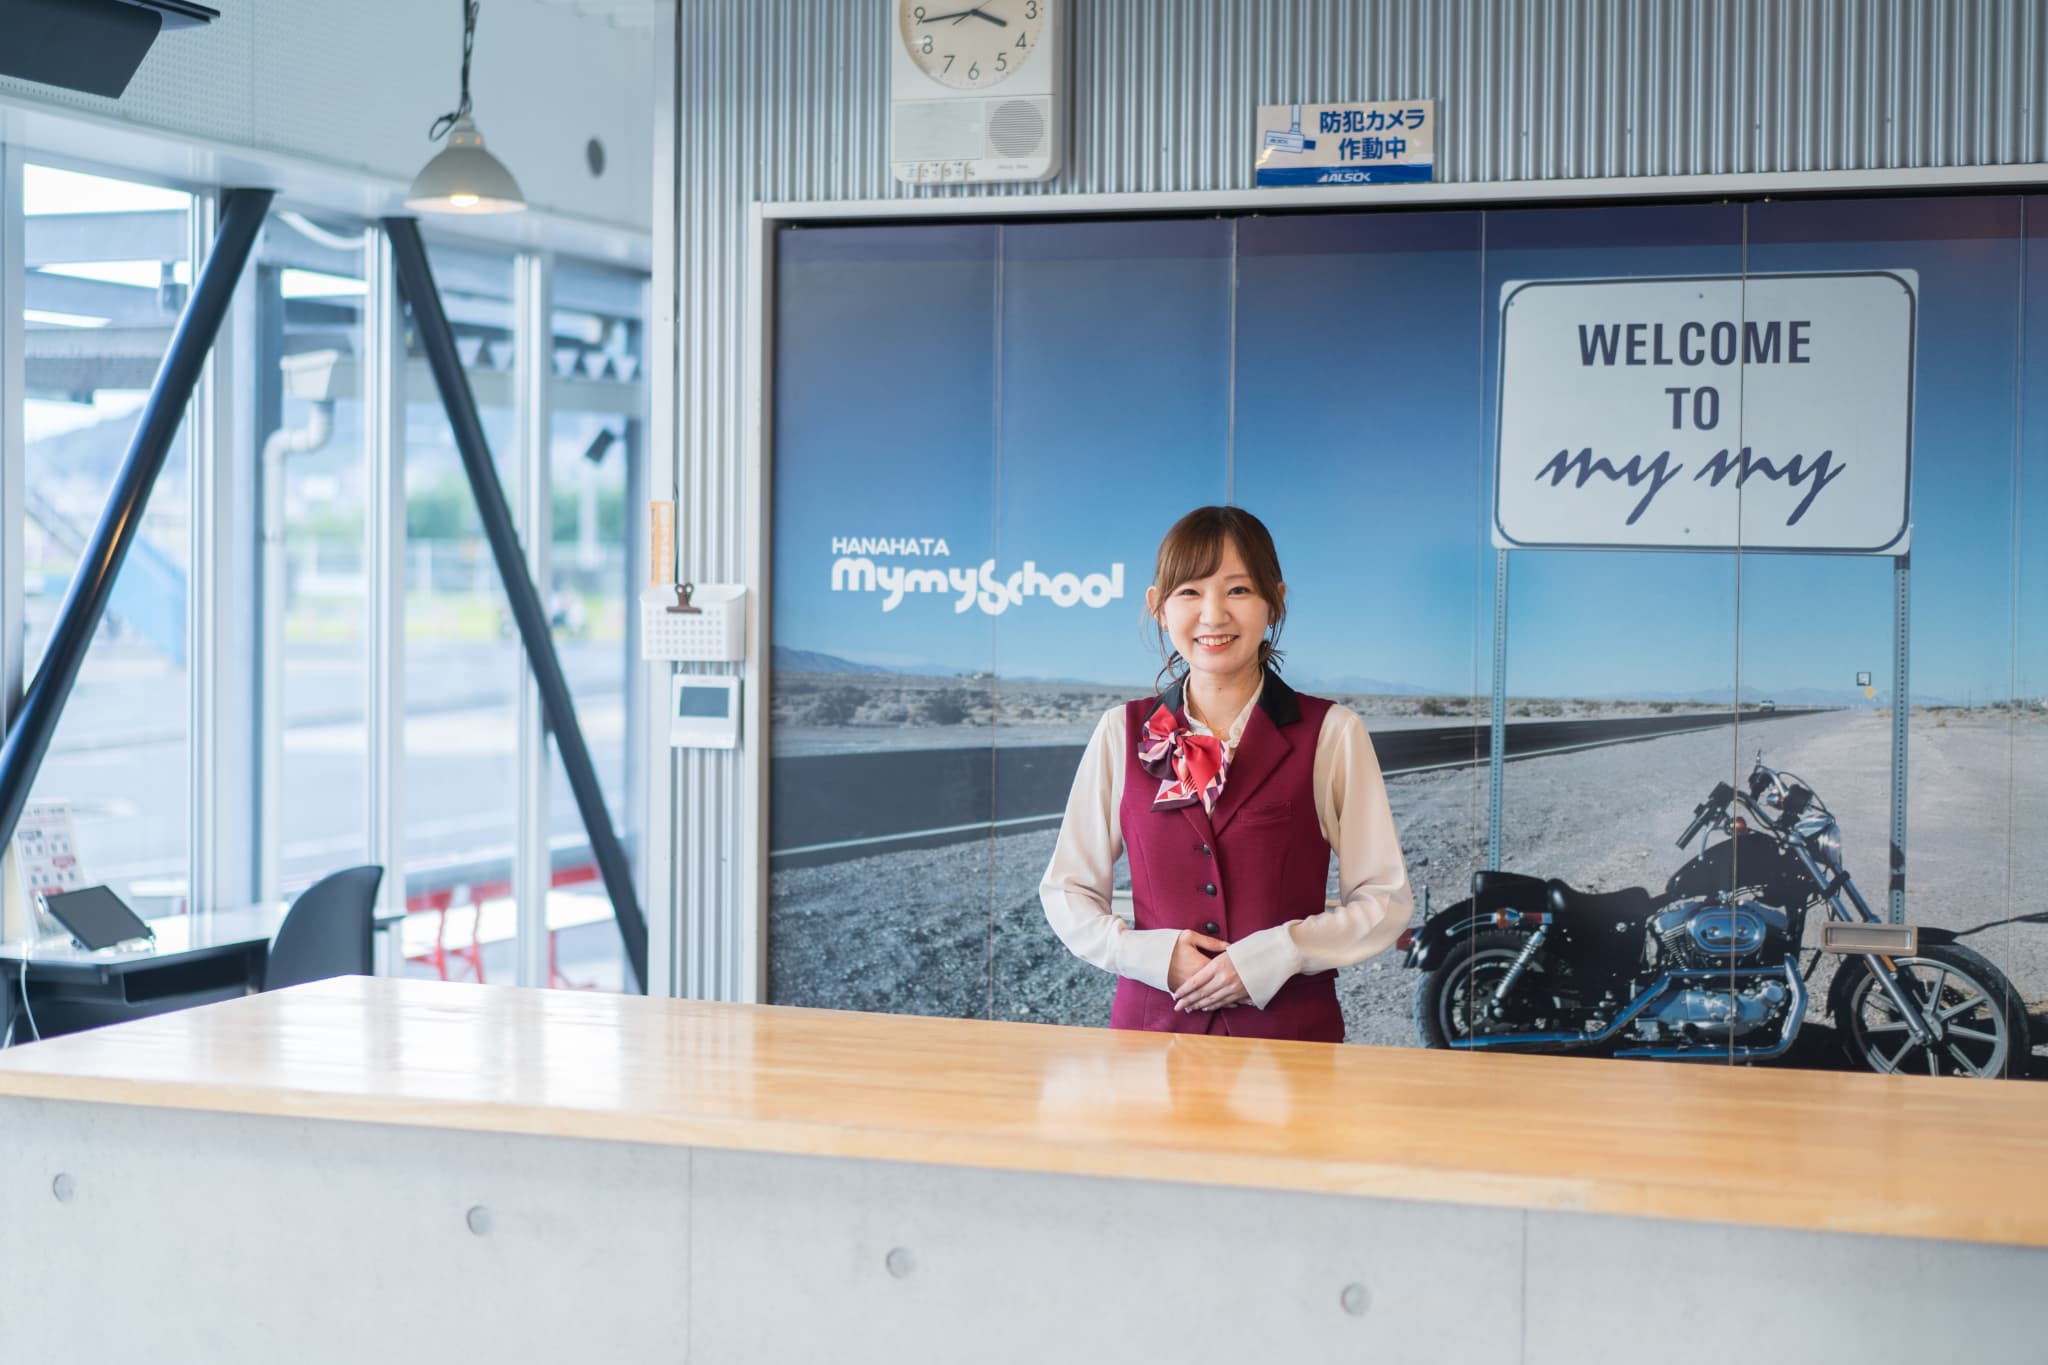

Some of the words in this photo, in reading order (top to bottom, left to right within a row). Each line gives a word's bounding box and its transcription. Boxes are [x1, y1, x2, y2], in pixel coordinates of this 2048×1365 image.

[914, 6, 926, 26] 9
[1025, 0, 1038, 19] 3
[921, 35, 934, 55] 8
[1015, 31, 1027, 48] 4
[943, 55, 956, 74] 7
[968, 61, 980, 81] 6
[995, 52, 1007, 72] 5
[1319, 109, 1426, 134] 防犯カメラ
[1338, 136, 1407, 161] 作動中
[1325, 172, 1372, 183] ALSOK
[1578, 320, 1811, 367] WELCOME
[1664, 386, 1720, 431] TO
[1534, 446, 1684, 527] my
[1693, 446, 1847, 527] my
[832, 536, 950, 556] HANAHATA
